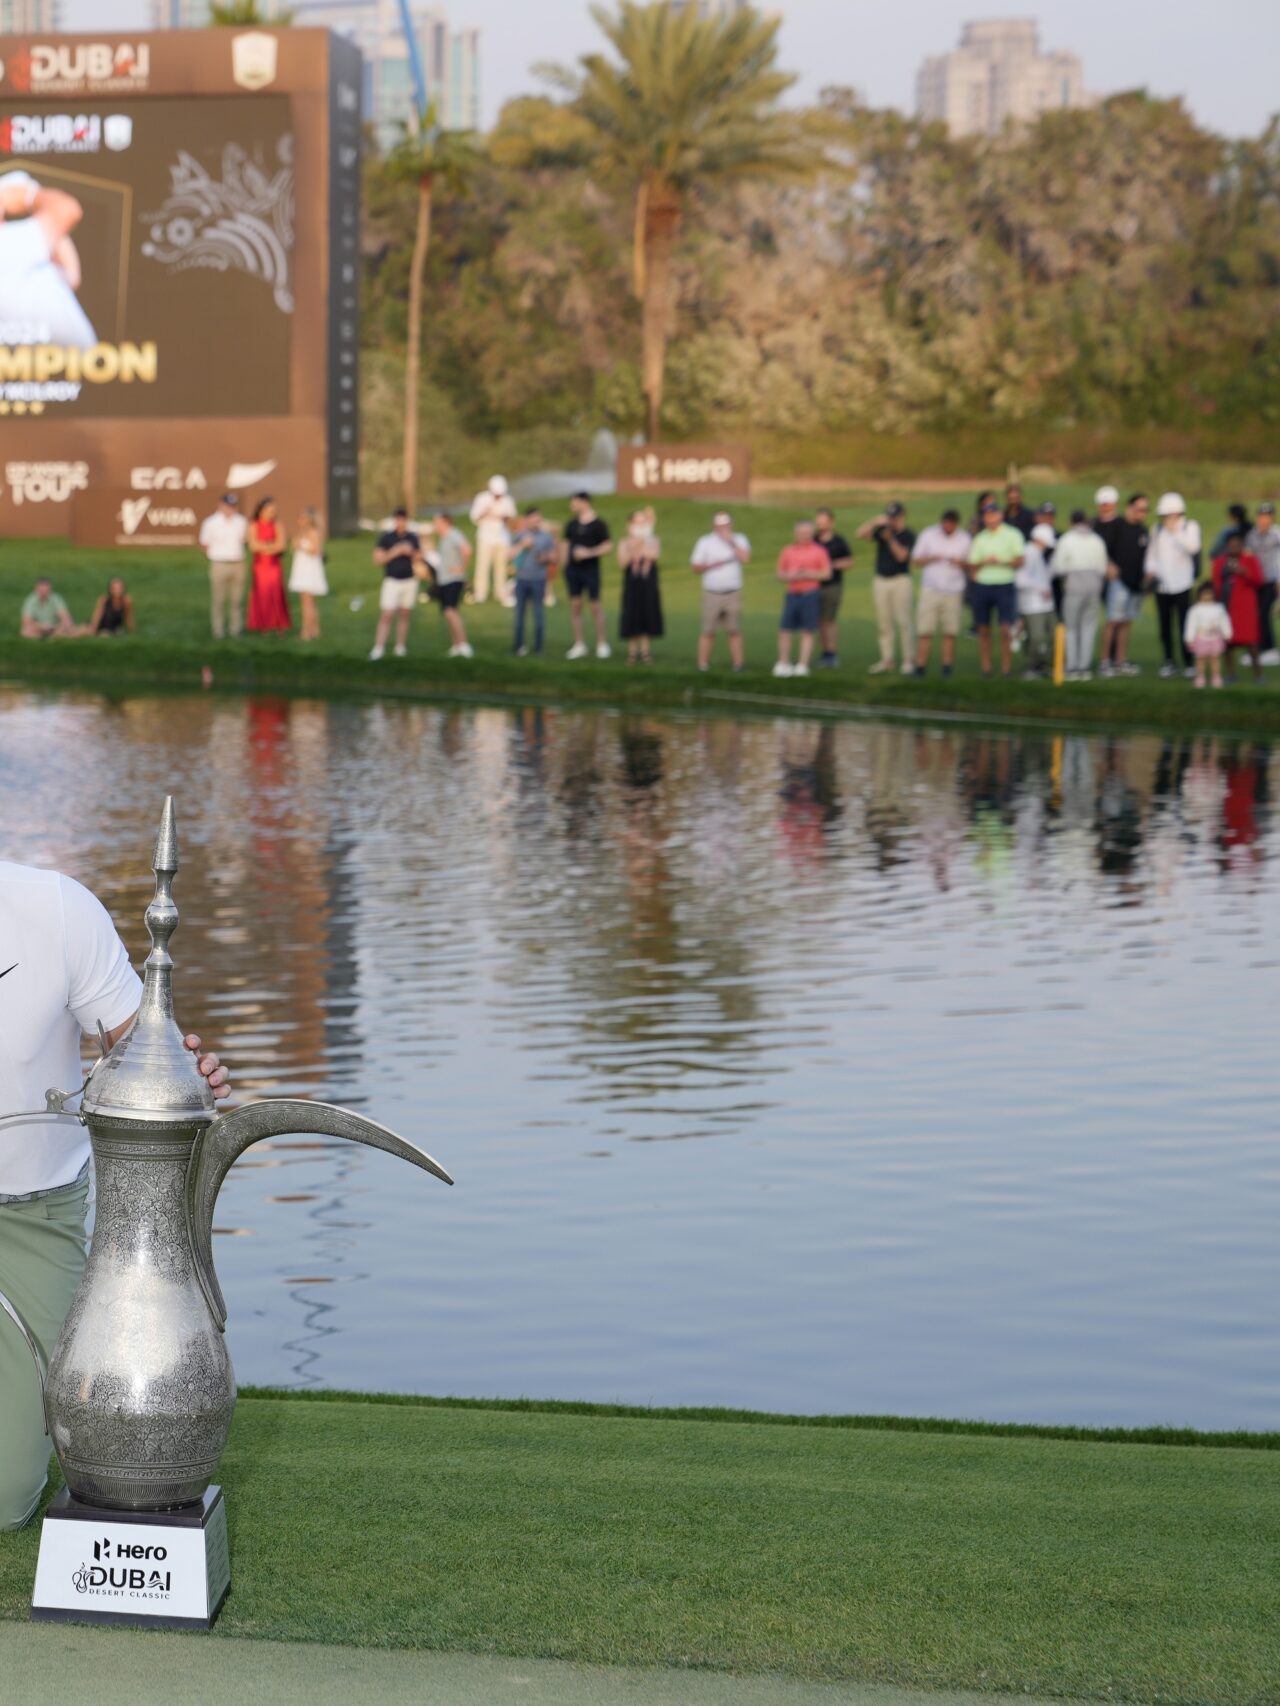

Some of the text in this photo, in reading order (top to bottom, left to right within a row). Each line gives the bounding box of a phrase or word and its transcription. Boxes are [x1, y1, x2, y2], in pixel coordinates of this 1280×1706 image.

[30, 43, 150, 80] DUBAI
[663, 458, 732, 483] Hero
[117, 1543, 168, 1561] Hero
[89, 1566, 171, 1591] DUBAI
[88, 1588, 171, 1600] DESERT CLASSIC
